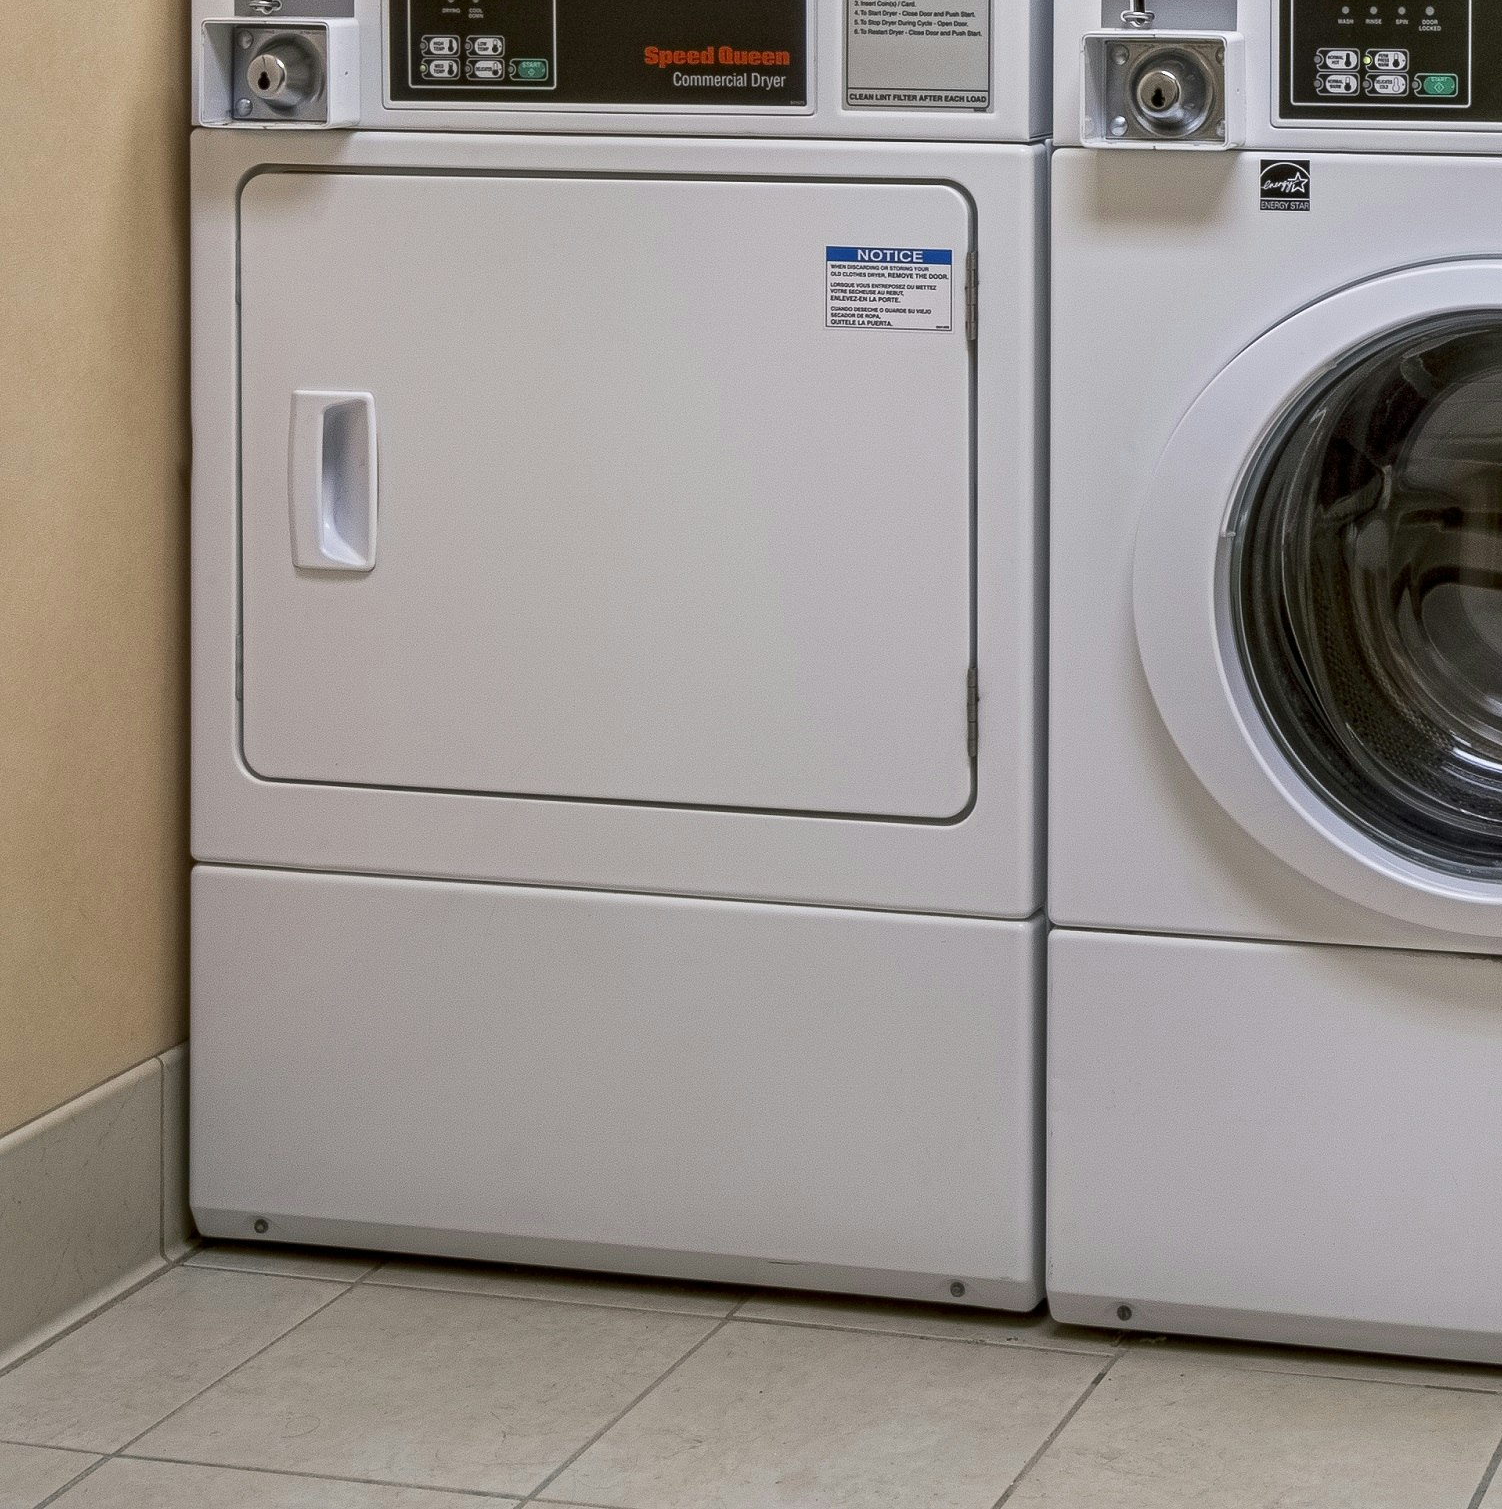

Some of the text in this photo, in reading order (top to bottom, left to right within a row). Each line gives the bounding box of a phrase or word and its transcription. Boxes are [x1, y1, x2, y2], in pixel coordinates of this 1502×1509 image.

[644, 46, 790, 68] Speed Queen
[673, 71, 786, 90] Commercial Dryer
[849, 93, 874, 101] CLEAN
[892, 94, 918, 102] FILTER
[918, 94, 943, 102] AFTER
[966, 95, 986, 103] LOAD
[1261, 201, 1310, 210] ENERGY STAR
[857, 249, 924, 263] NOTICE
